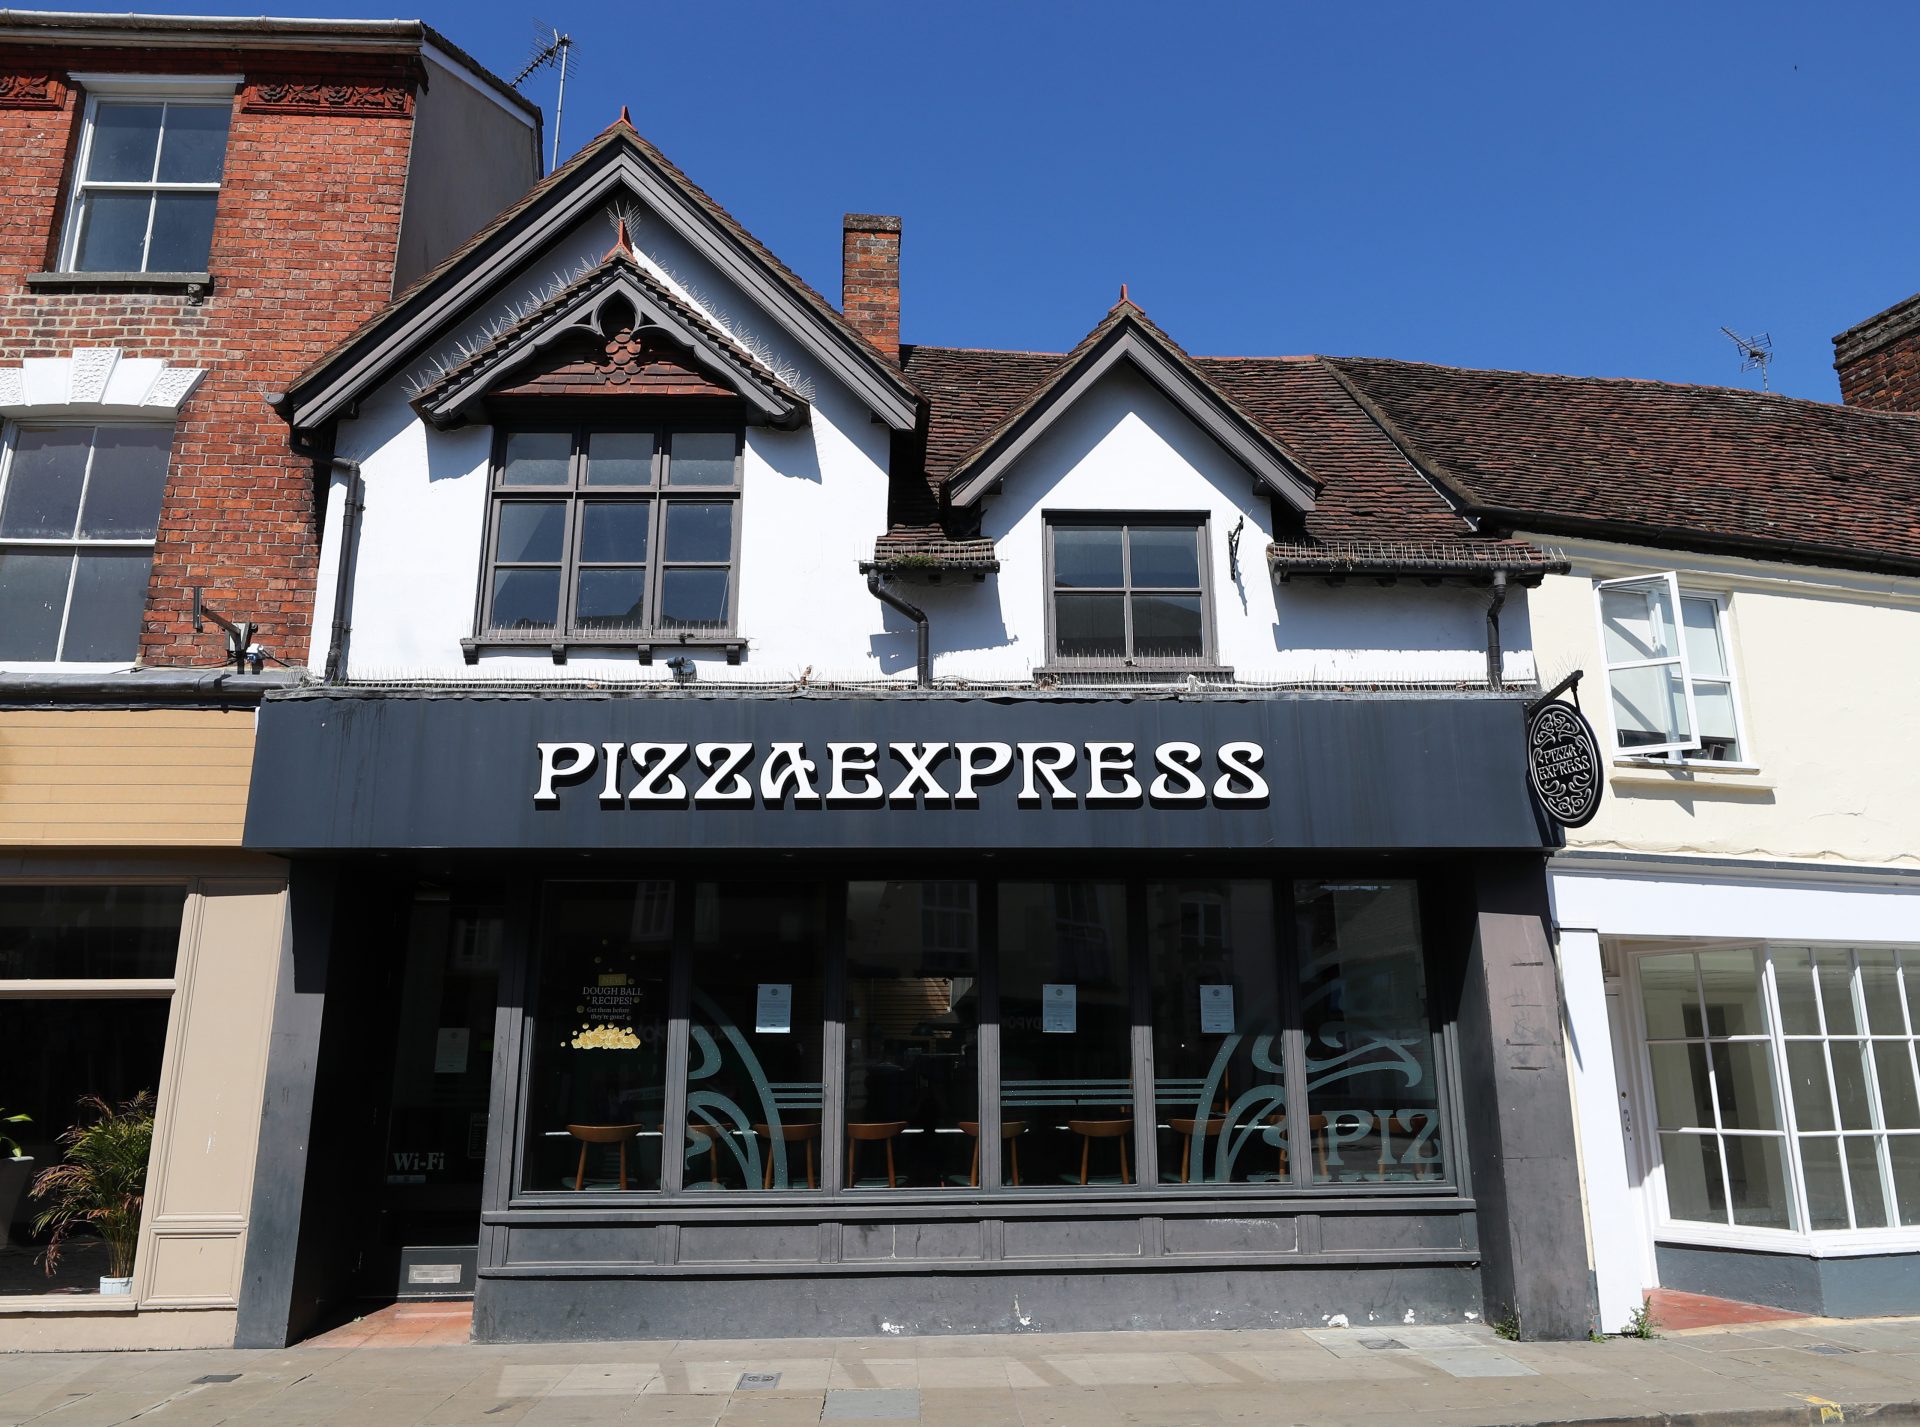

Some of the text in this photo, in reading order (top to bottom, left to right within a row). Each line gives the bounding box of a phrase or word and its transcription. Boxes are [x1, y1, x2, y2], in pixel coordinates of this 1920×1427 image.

[1543, 743, 1578, 764] PIZZA
[533, 741, 1270, 803] PIZZAEXPRESS
[1537, 755, 1590, 780] EXPRESS
[583, 986, 643, 996] DOUGH BALL
[592, 996, 633, 1005] RECIPES!
[392, 1152, 445, 1170] Wi-Fi
